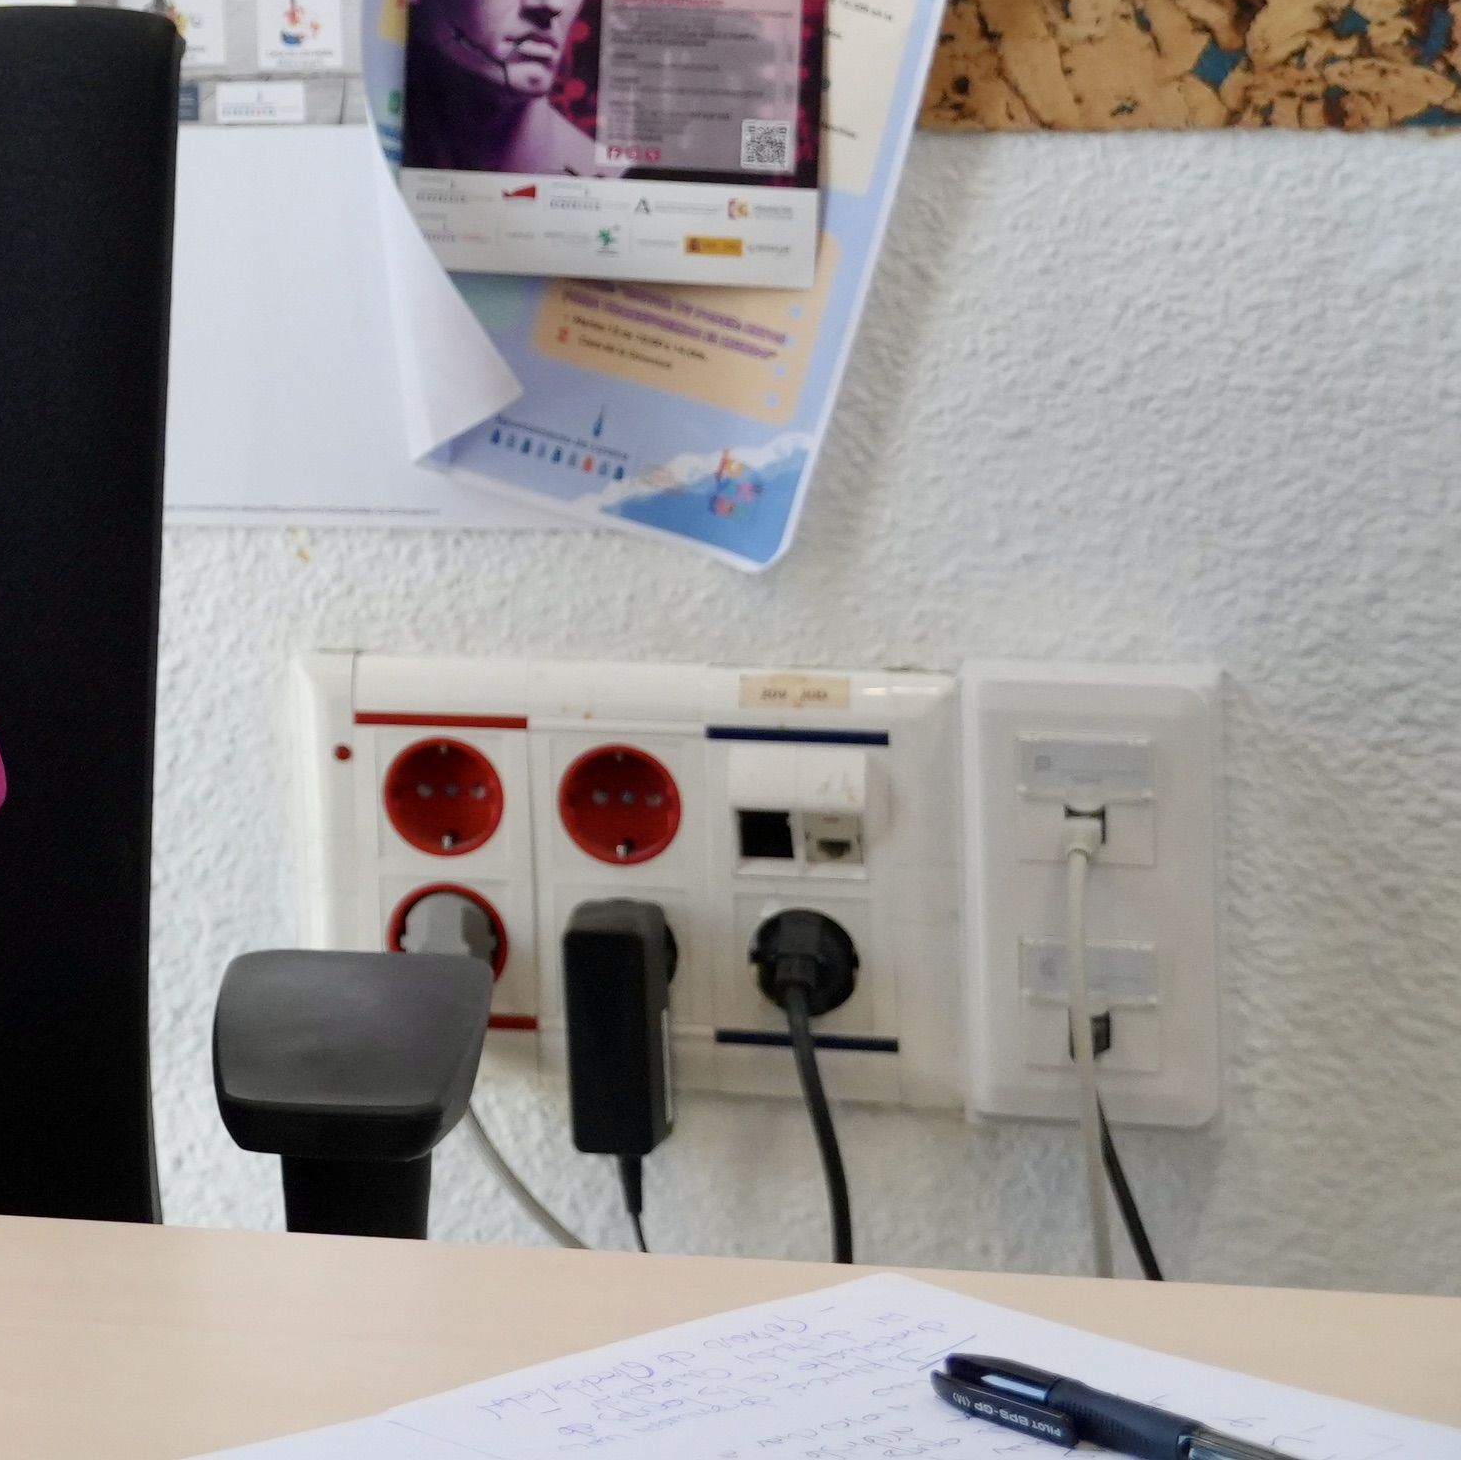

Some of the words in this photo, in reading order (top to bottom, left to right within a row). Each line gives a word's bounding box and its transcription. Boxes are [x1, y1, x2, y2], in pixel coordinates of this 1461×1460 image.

[952, 1391, 971, 1408] (M)
[973, 1401, 1028, 1426] BPS-GP
[1031, 1419, 1061, 1436] PILOT
